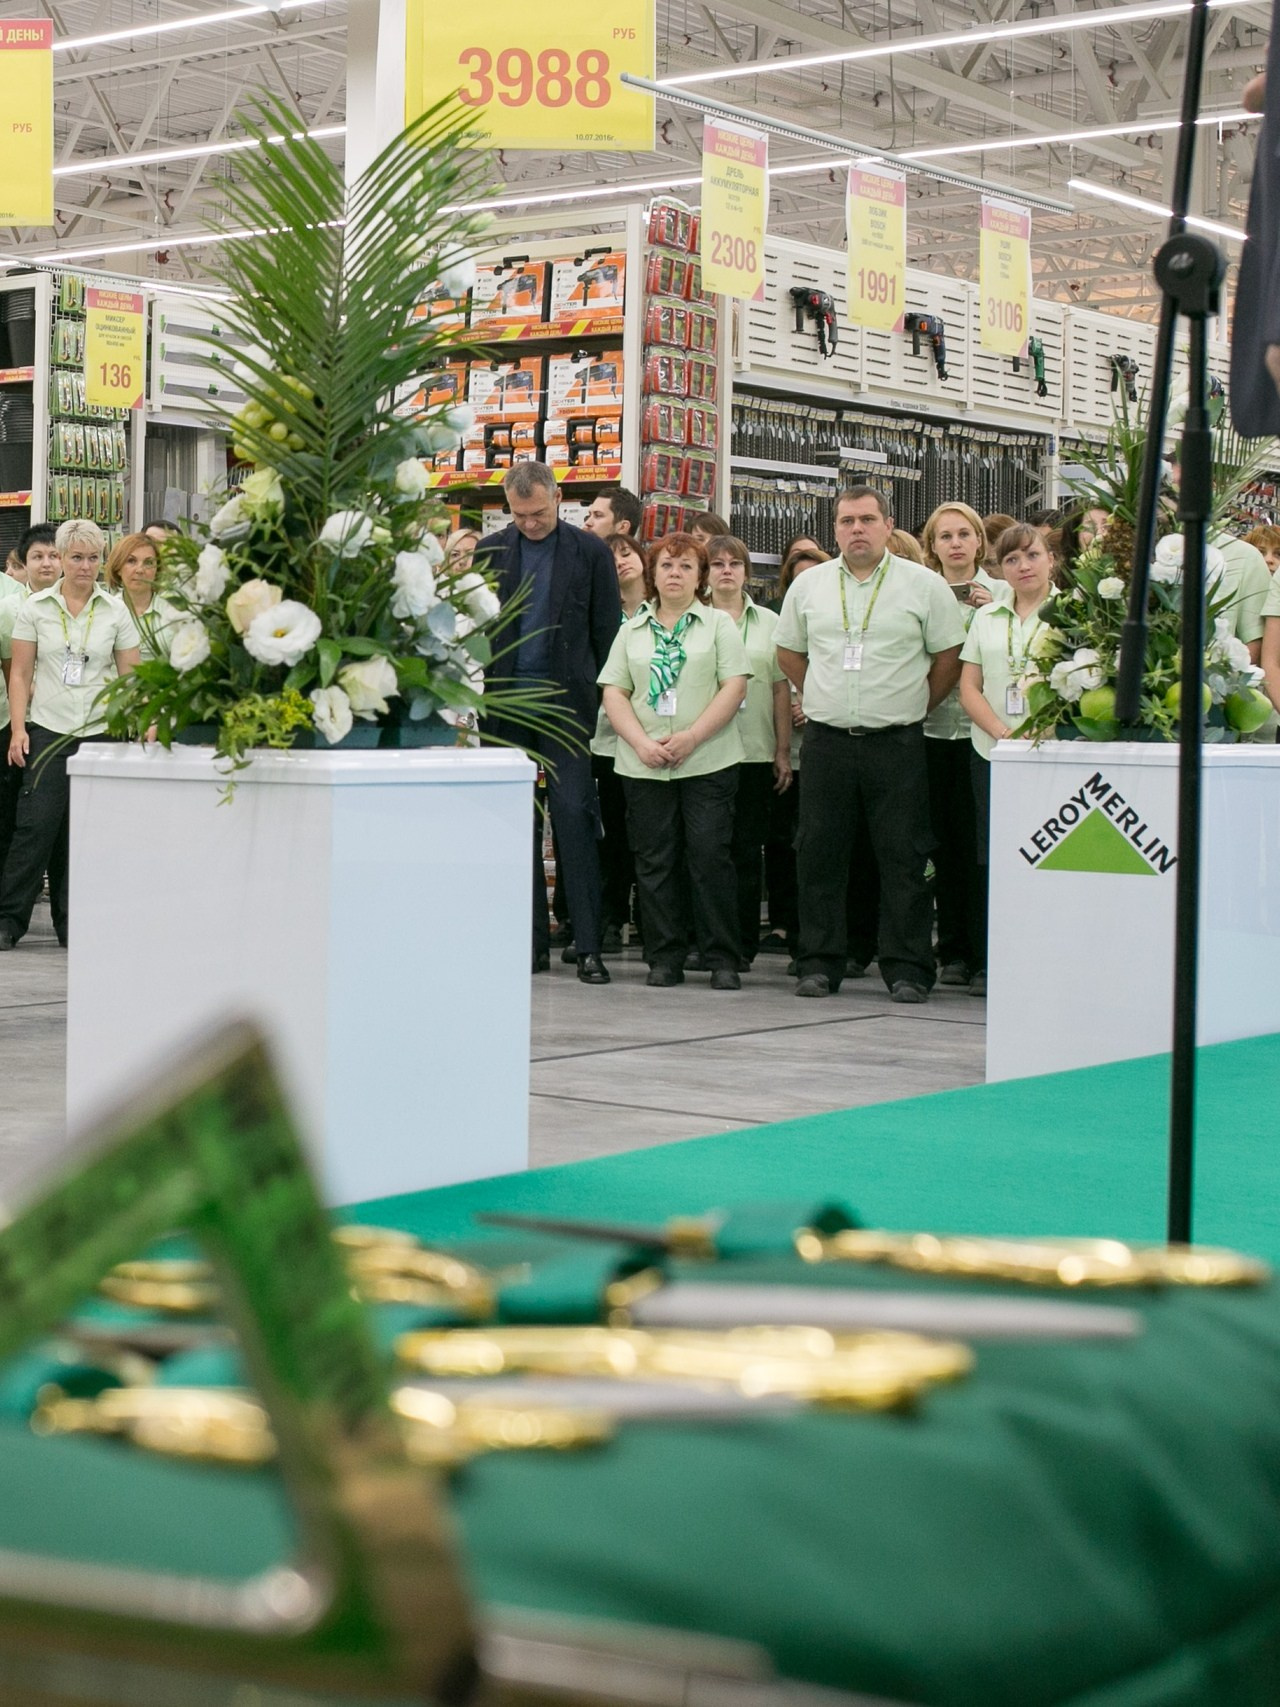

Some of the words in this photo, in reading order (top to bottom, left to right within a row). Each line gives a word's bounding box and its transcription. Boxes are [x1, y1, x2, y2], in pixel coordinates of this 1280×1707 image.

[6, 28, 44, 43] ДЕНЬ!
[612, 27, 637, 40] РУБ
[458, 47, 612, 108] 3988
[12, 123, 33, 133] РУБ
[710, 230, 757, 274] 2308
[858, 267, 897, 306] 1991
[987, 297, 1023, 333] 3106
[99, 362, 132, 389] 136
[1018, 787, 1092, 866] LEROY
[1084, 771, 1179, 875] MERLIN
